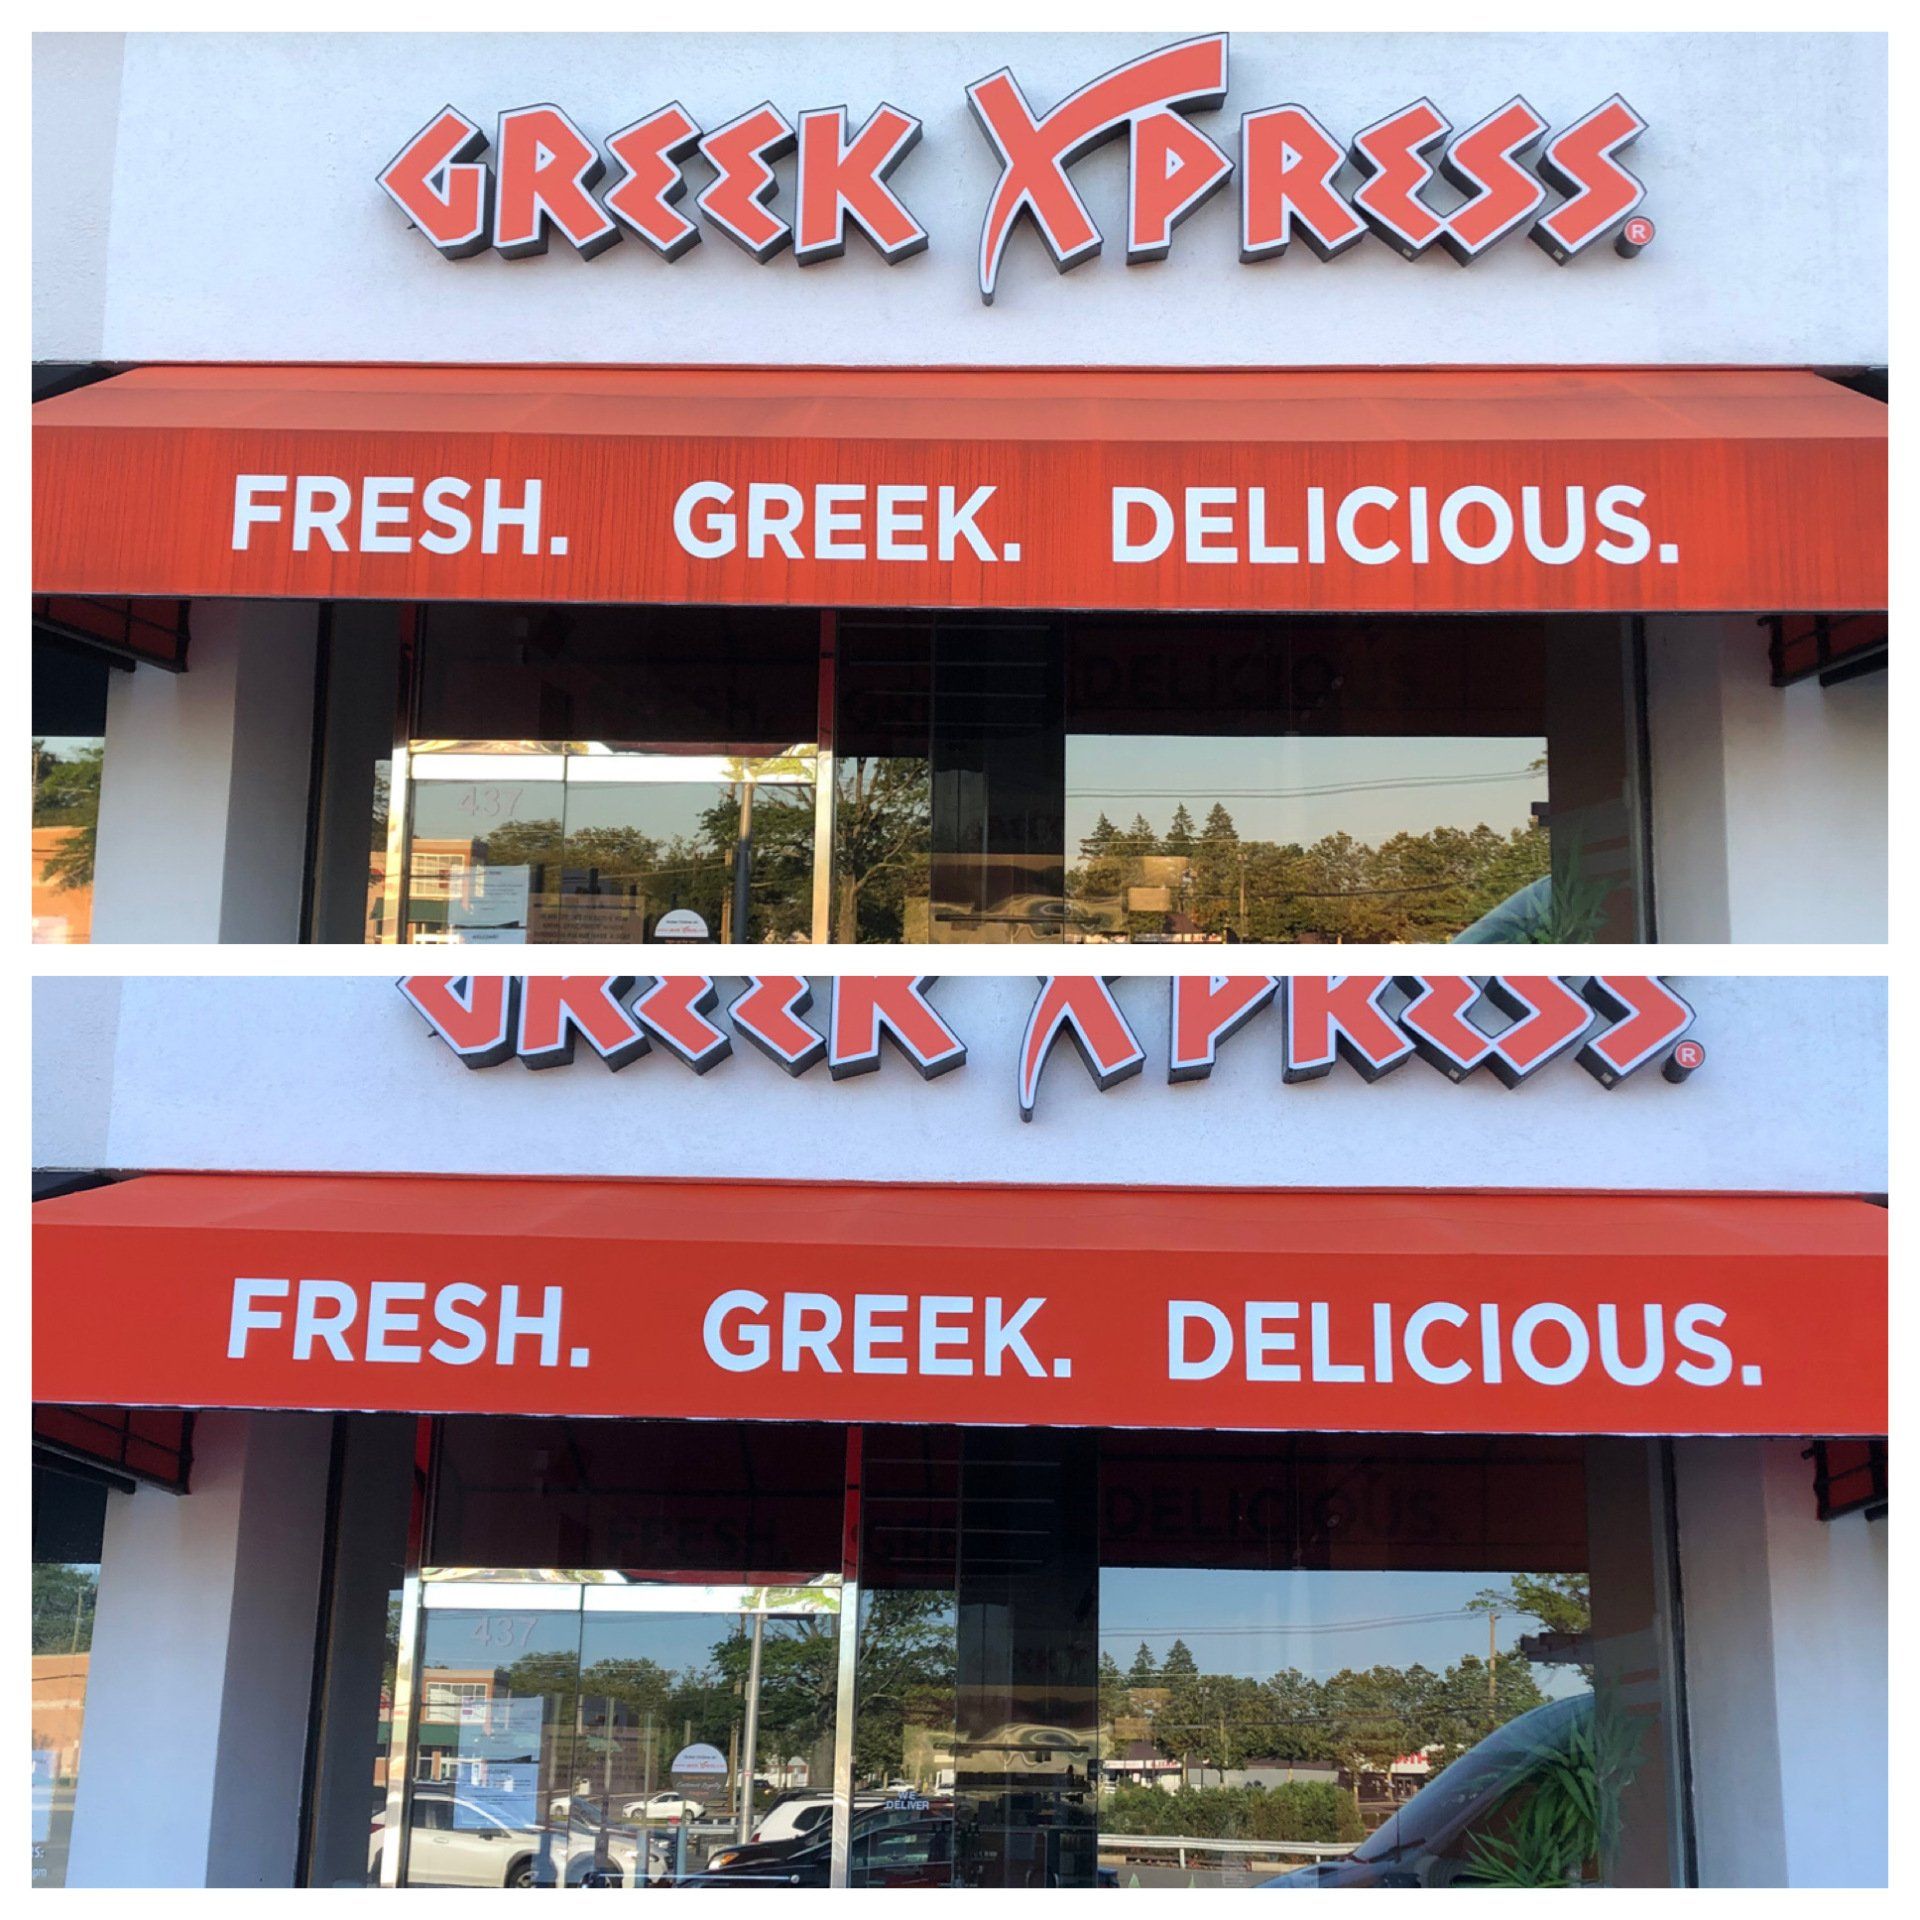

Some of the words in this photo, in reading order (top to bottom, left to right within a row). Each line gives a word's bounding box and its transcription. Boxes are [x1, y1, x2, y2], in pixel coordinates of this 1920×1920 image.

[375, 100, 928, 264] GREEK
[965, 32, 1649, 302] XPRESS
[233, 475, 567, 554] FRESH.
[674, 482, 1020, 561] GREEK.
[1113, 486, 1678, 564] DELICIOUS.
[460, 786, 523, 817] 437
[228, 1279, 588, 1366] FRESH.
[704, 1290, 1070, 1377] GREEK.
[1169, 1301, 1761, 1385] DELICIOUS.
[471, 1616, 539, 1647] 437
[884, 1801, 929, 1810] DELIVER
[898, 1791, 916, 1800] WE
